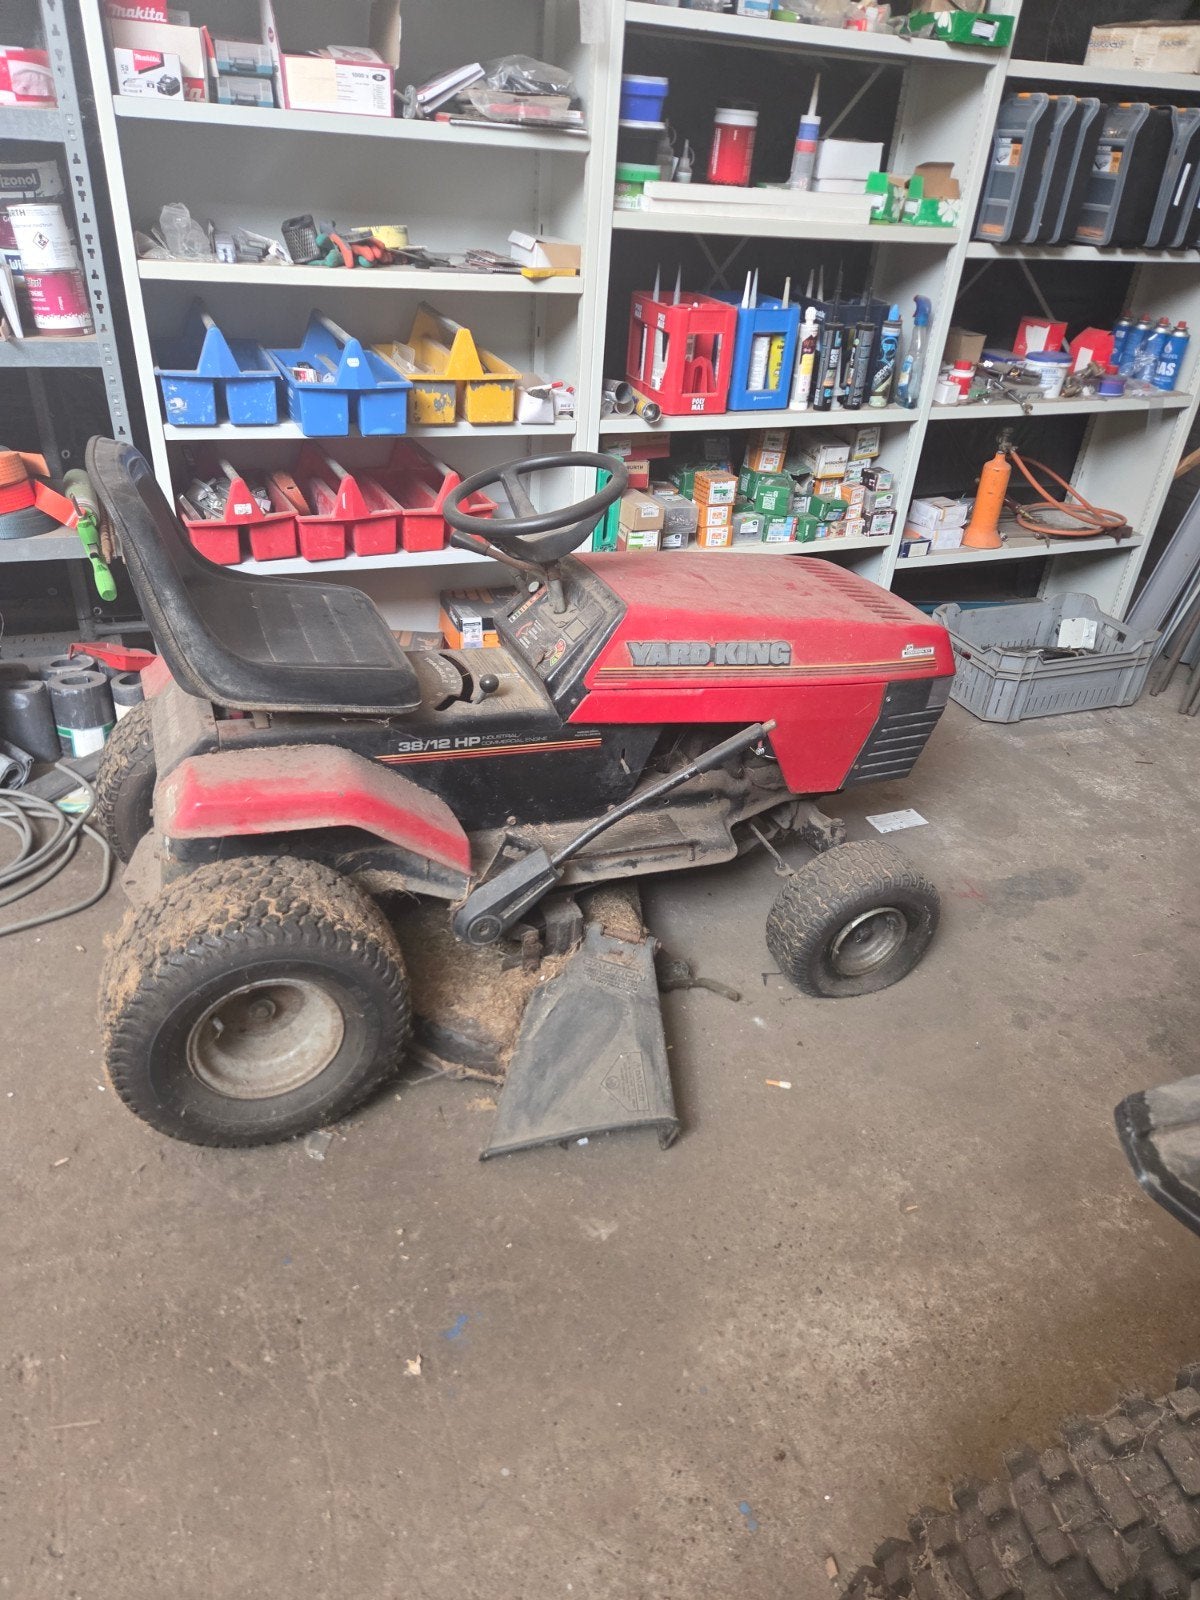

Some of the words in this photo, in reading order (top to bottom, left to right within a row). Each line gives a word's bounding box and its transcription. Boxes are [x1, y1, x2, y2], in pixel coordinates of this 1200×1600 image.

[111, 5, 167, 22] makita
[691, 397, 706, 405] POLY
[691, 403, 705, 411] MAX
[627, 642, 711, 667] YARD
[714, 641, 792, 667] KING
[398, 738, 451, 752] 38/12
[454, 736, 482, 748] HP
